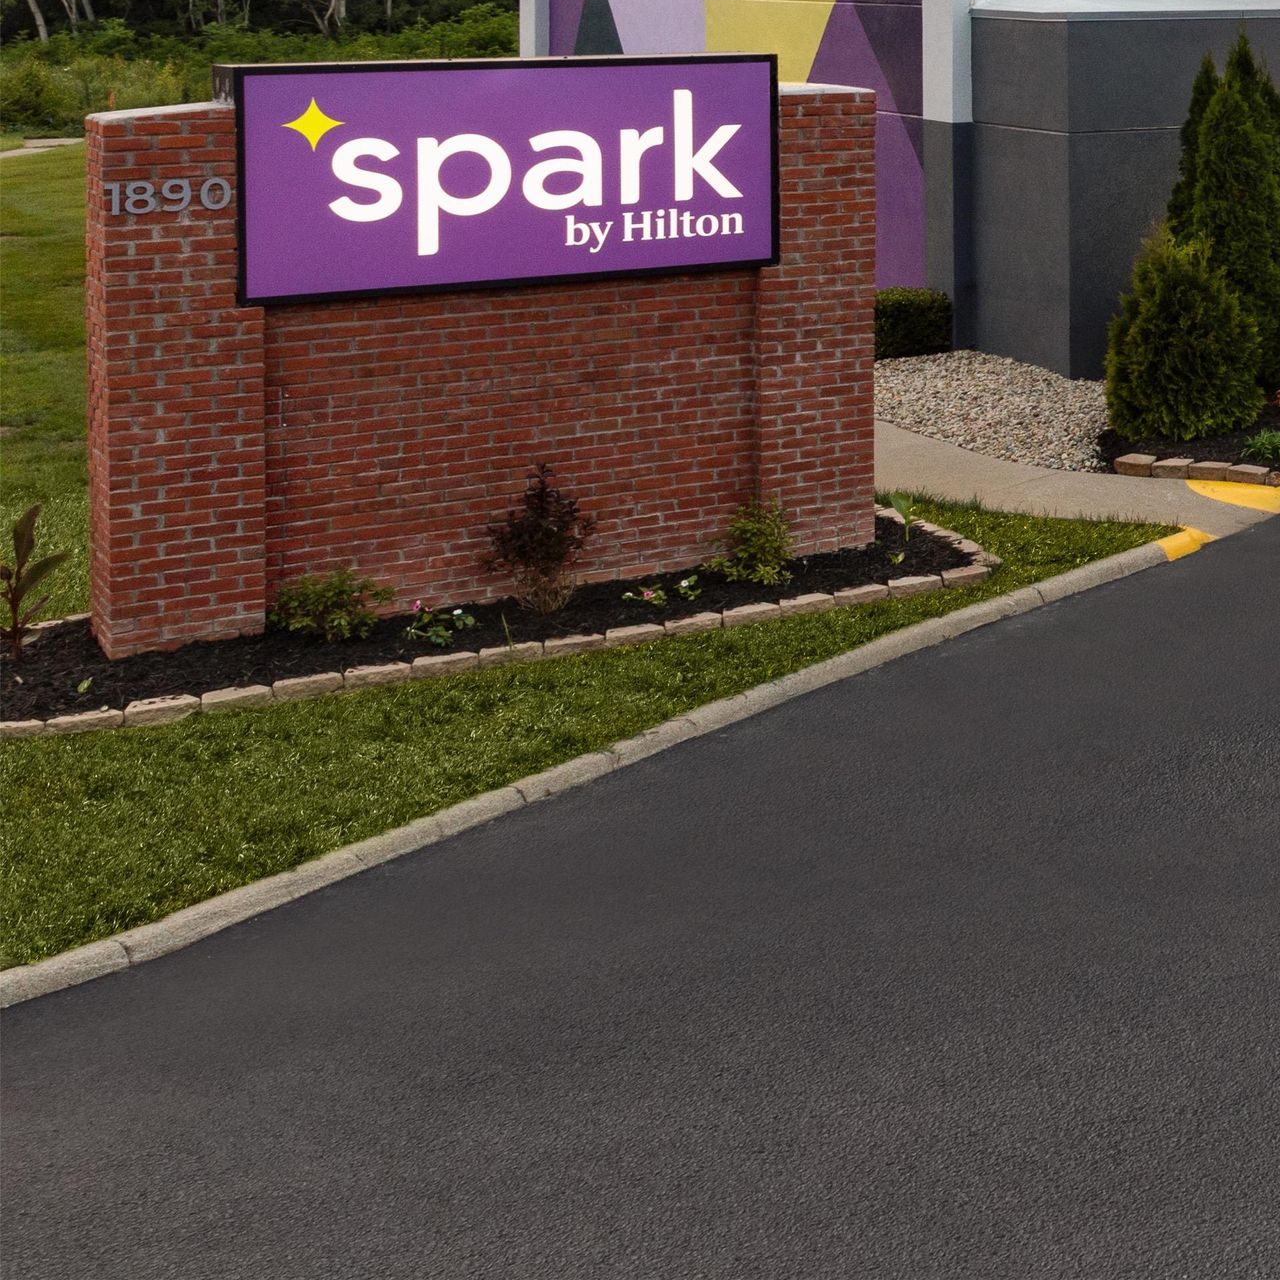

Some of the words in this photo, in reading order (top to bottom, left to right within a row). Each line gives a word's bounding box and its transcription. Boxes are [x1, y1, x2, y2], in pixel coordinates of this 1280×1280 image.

[328, 89, 744, 256] spark
[103, 177, 232, 216] 1890
[565, 214, 614, 253] by
[622, 208, 744, 242] Hilton
